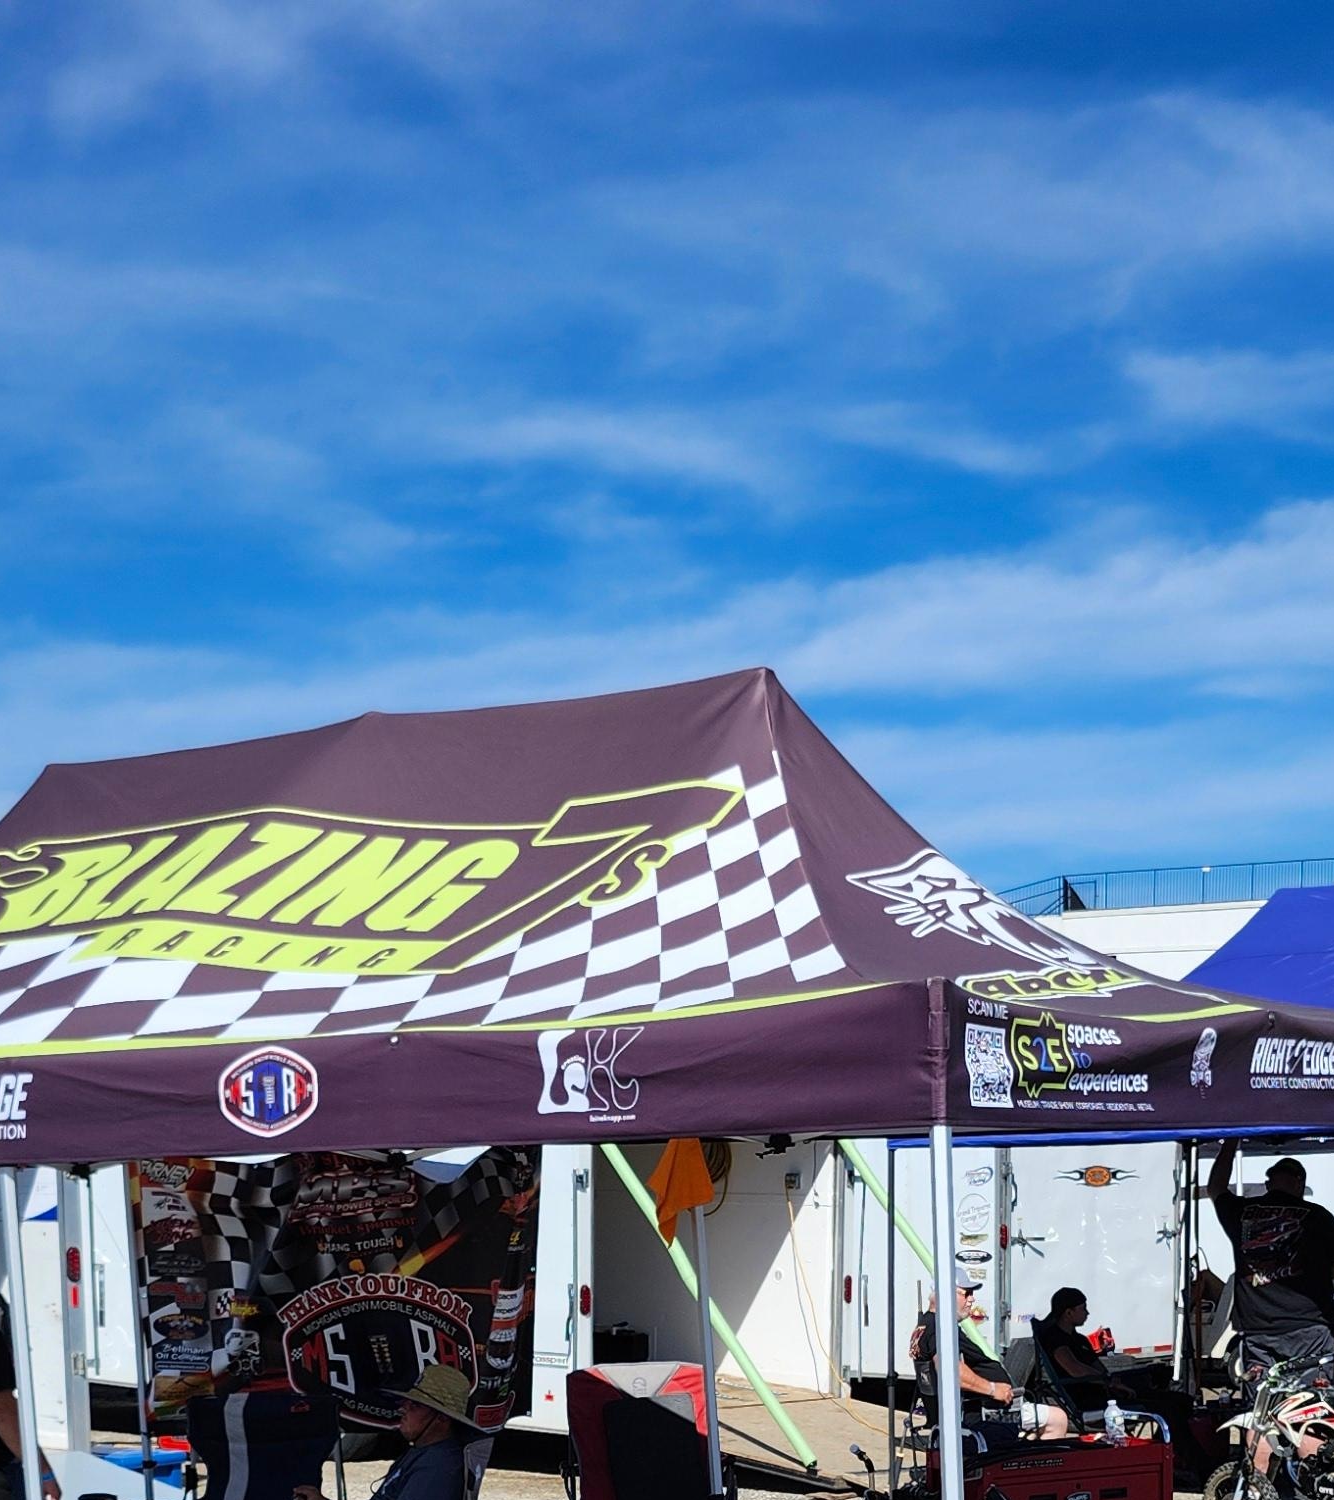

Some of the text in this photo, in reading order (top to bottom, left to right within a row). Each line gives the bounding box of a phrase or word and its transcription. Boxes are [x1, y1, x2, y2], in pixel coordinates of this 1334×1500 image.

[107, 927, 398, 969] RACING
[967, 998, 1009, 1020] SCAN ME
[1067, 1024, 1121, 1048] spaces
[1017, 1035, 1068, 1072] S2E
[1071, 1048, 1092, 1069] to
[1250, 1037, 1297, 1074] RIGHT
[1250, 1077, 1288, 1089] CONCRETE
[336, 1200, 372, 1212] POWER
[354, 1236, 395, 1250] TOUGH
[278, 1273, 473, 1325] THANK YOU FROM
[301, 1308, 343, 1337] MICHIGAN
[415, 1307, 459, 1337] ASPHALT
[155, 1352, 210, 1363] Oil Company
[300, 1322, 462, 1395] MSRA
[357, 1401, 393, 1419] RACERS
